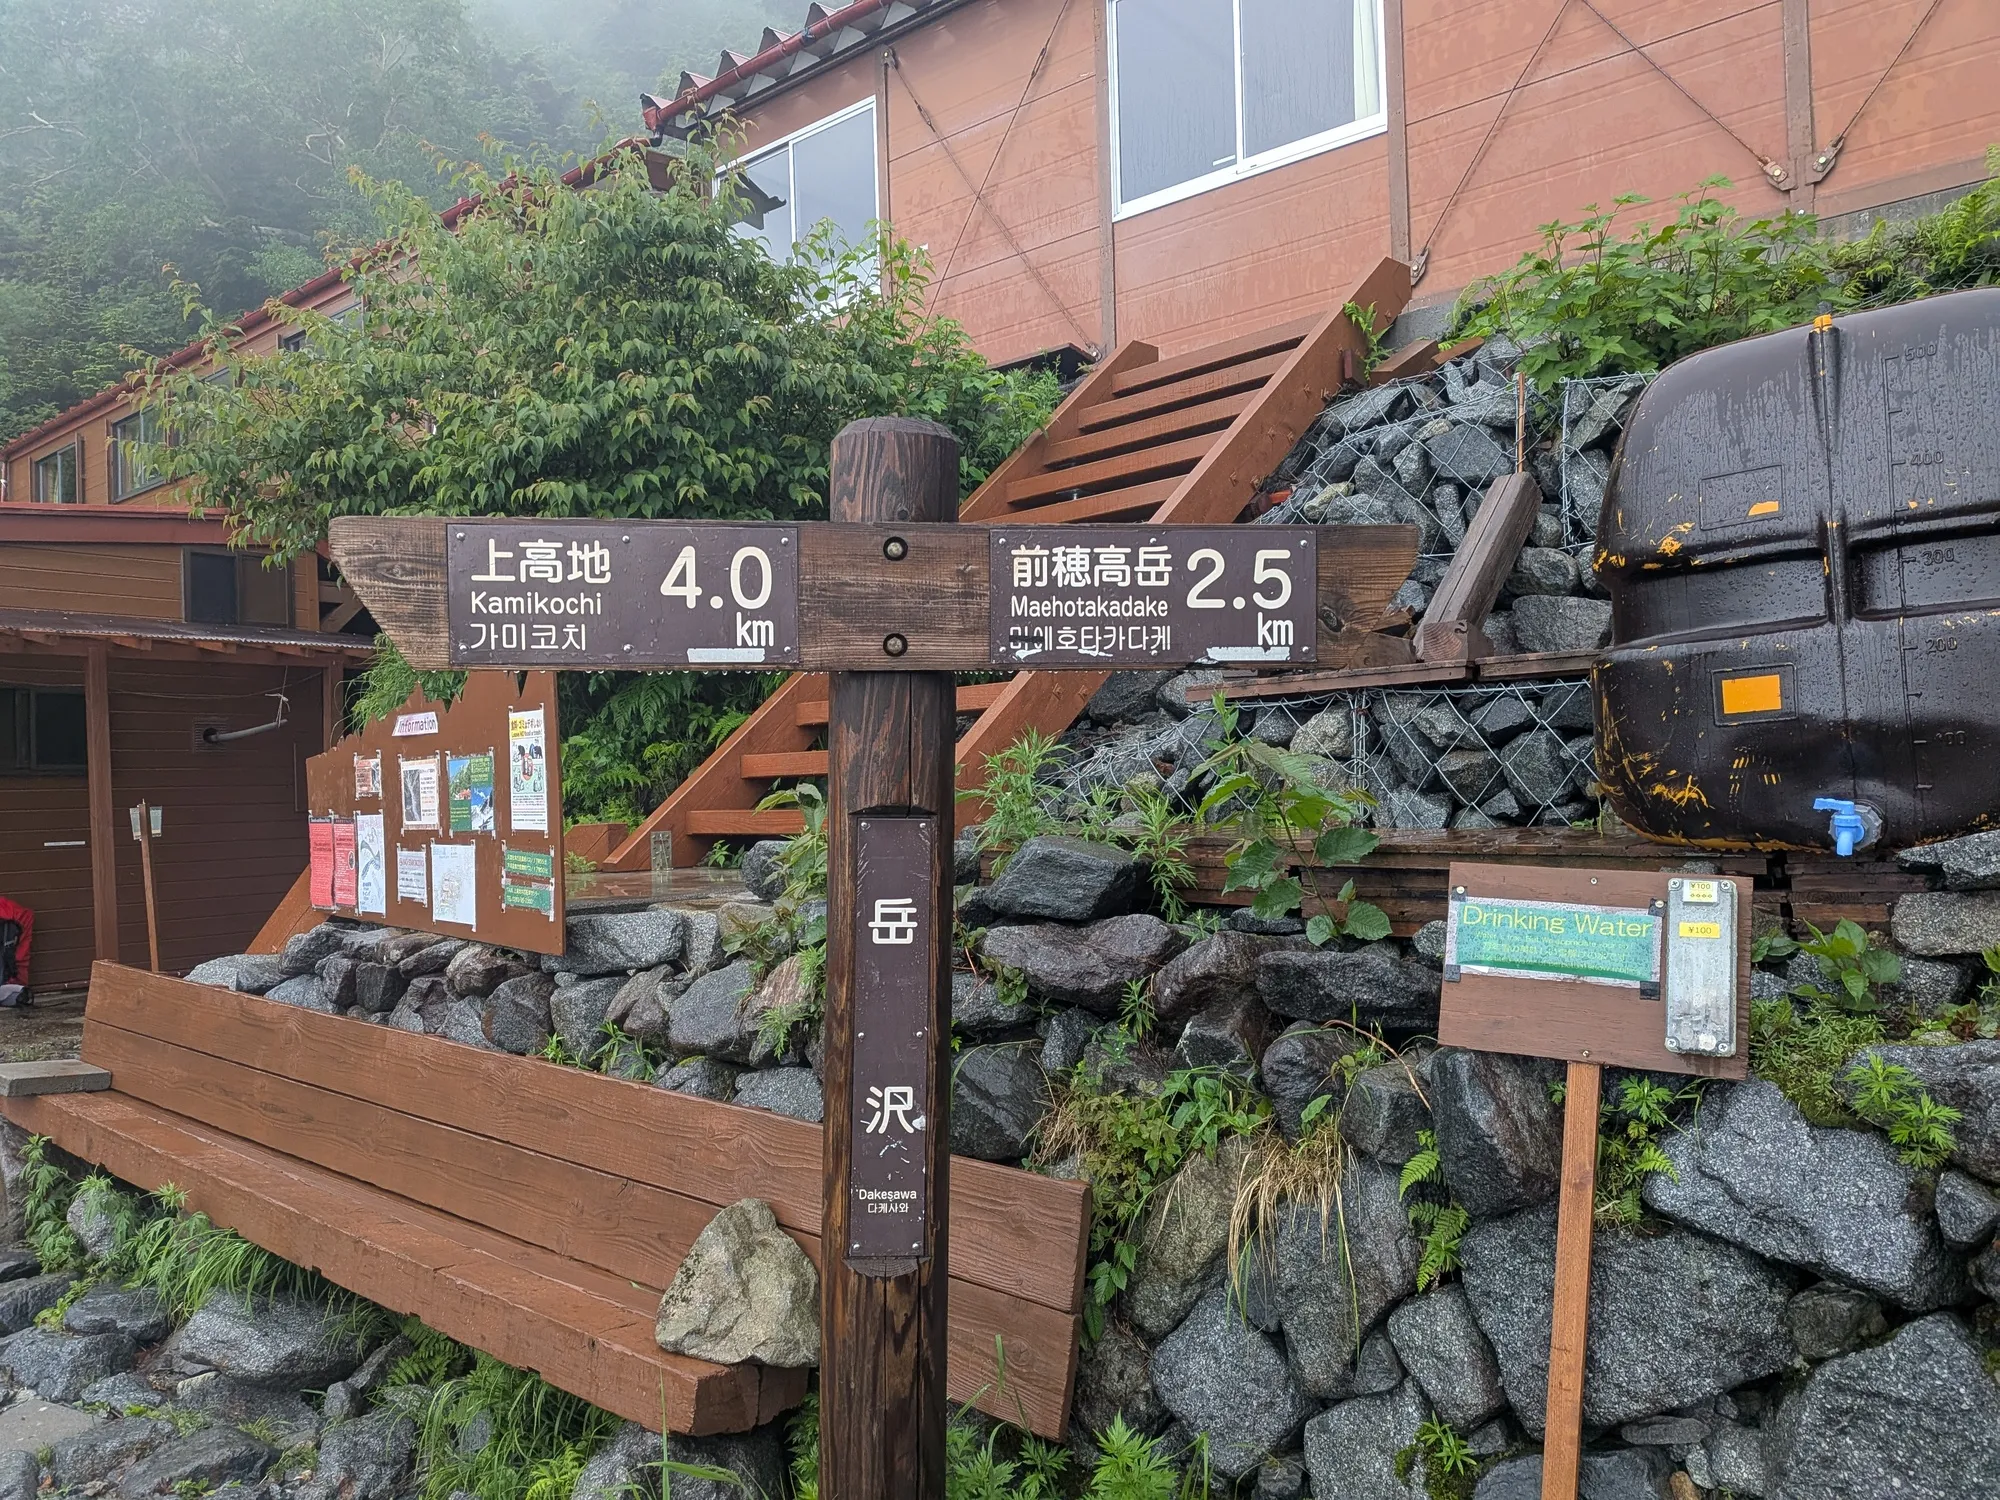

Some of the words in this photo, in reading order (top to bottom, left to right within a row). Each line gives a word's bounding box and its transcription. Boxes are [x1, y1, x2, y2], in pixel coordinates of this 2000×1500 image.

[1904, 343, 1938, 361] 500
[1910, 451, 1944, 466] 400
[471, 538, 611, 583] 上高地
[1011, 544, 1173, 587] 前穂高岳
[1922, 548, 1955, 566] 300
[660, 545, 773, 609] 4.0
[1186, 548, 1292, 609] 2.5
[471, 591, 602, 615] Kamikochi
[1010, 595, 1168, 618] Maehotakadake
[470, 623, 587, 650] 가미코치
[736, 612, 774, 647] km
[1257, 612, 1294, 646] km
[1925, 637, 1958, 656] 200
[1463, 905, 1566, 934] Drinking
[1574, 913, 1653, 938] Water
[1688, 926, 1712, 934] ¥100
[867, 897, 918, 1134] 岳沢
[859, 1188, 917, 1200] Dakesawa
[867, 1202, 909, 1213] 다케사와
